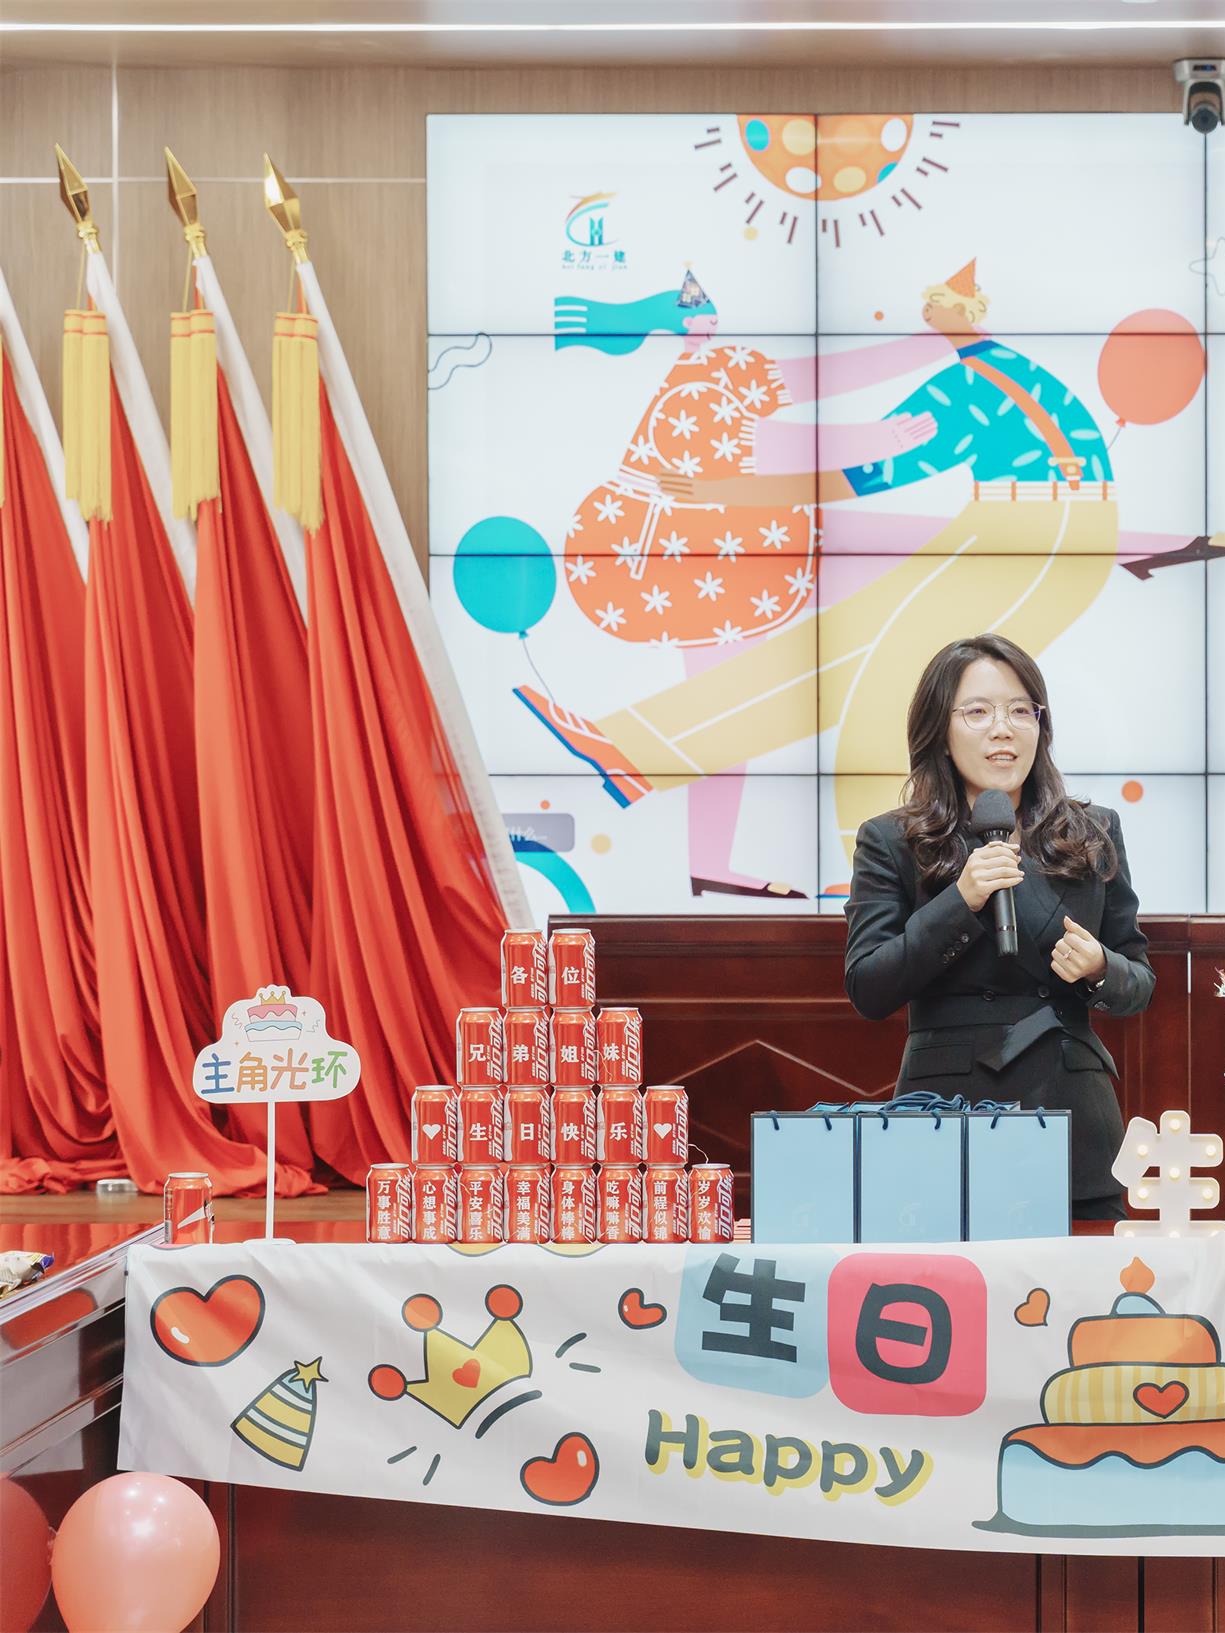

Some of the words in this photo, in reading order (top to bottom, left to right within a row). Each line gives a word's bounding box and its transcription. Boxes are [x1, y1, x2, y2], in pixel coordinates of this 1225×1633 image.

[200, 1047, 348, 1095] 主角光环
[377, 1180, 392, 1240] 万事胜意
[422, 1181, 437, 1240] 心想事成
[516, 1181, 531, 1240] 幸福美满
[561, 1180, 576, 1240] 身体棒棒
[606, 1181, 620, 1240] 吃嘛嘛香
[653, 1180, 668, 1240] 前程似锦
[698, 1180, 712, 1240] 岁岁欢愉
[702, 1253, 953, 1385] 生日
[643, 1409, 934, 1506] Happy
